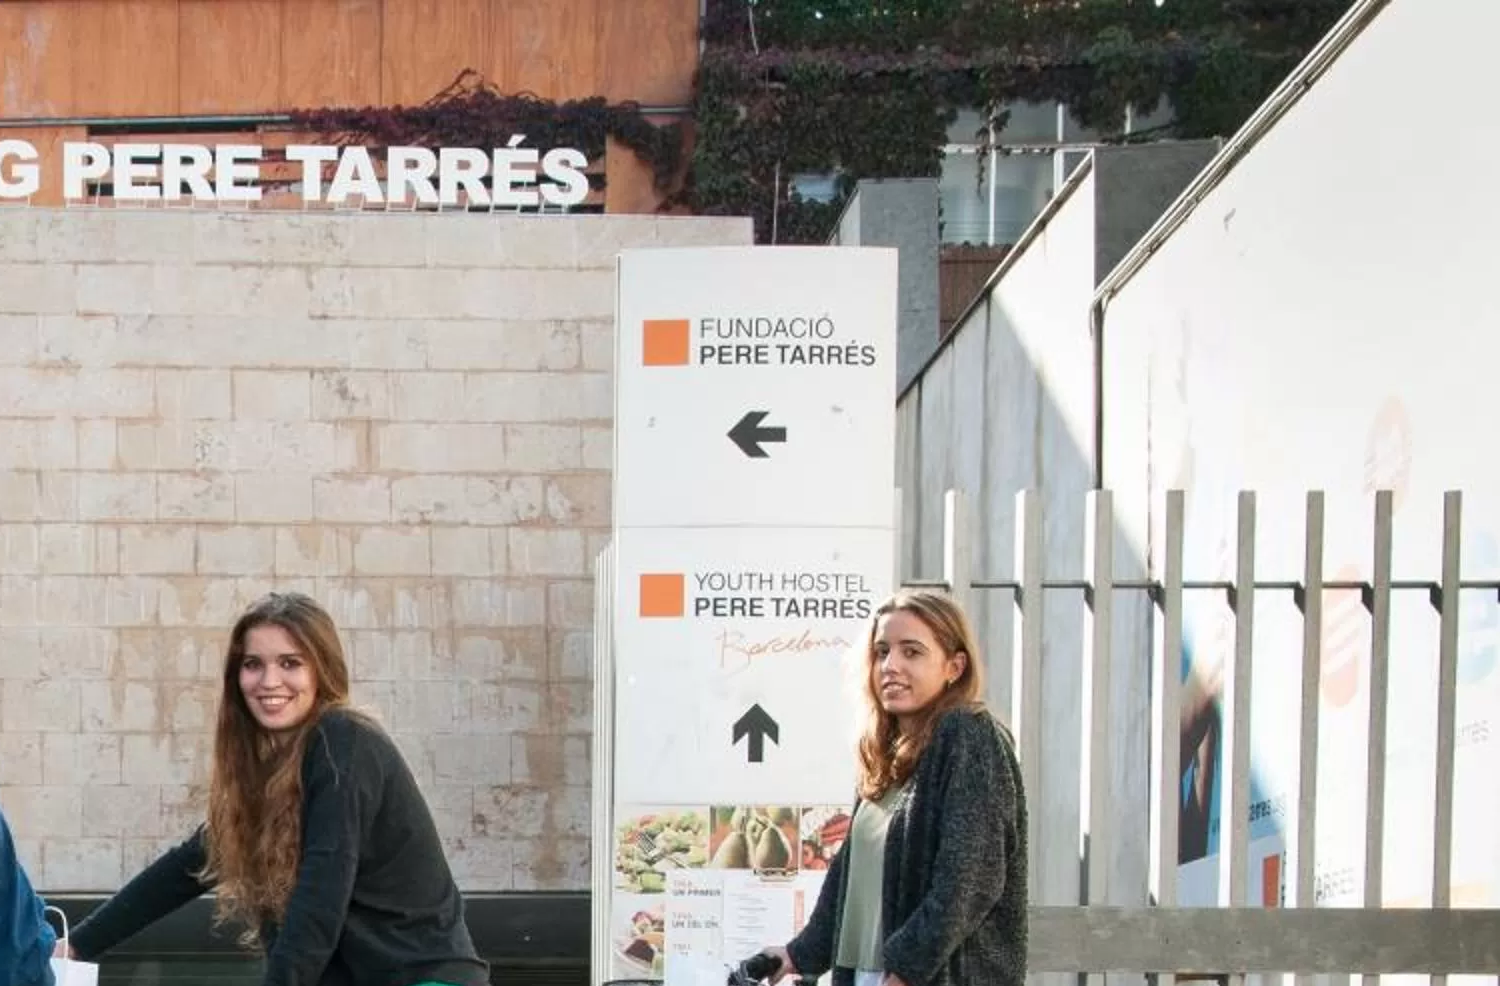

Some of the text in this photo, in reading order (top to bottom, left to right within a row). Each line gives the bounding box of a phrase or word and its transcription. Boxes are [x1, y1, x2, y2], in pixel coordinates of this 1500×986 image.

[63, 142, 264, 201] PERE
[285, 136, 591, 206] TARRÉS
[699, 312, 834, 340] FUNDACIÓ
[699, 339, 876, 367] PERE TARRÉS
[695, 572, 871, 595] YOUTH HOSTEL
[694, 592, 871, 620] PERE TARRÉS
[715, 626, 853, 675] Barcelona
